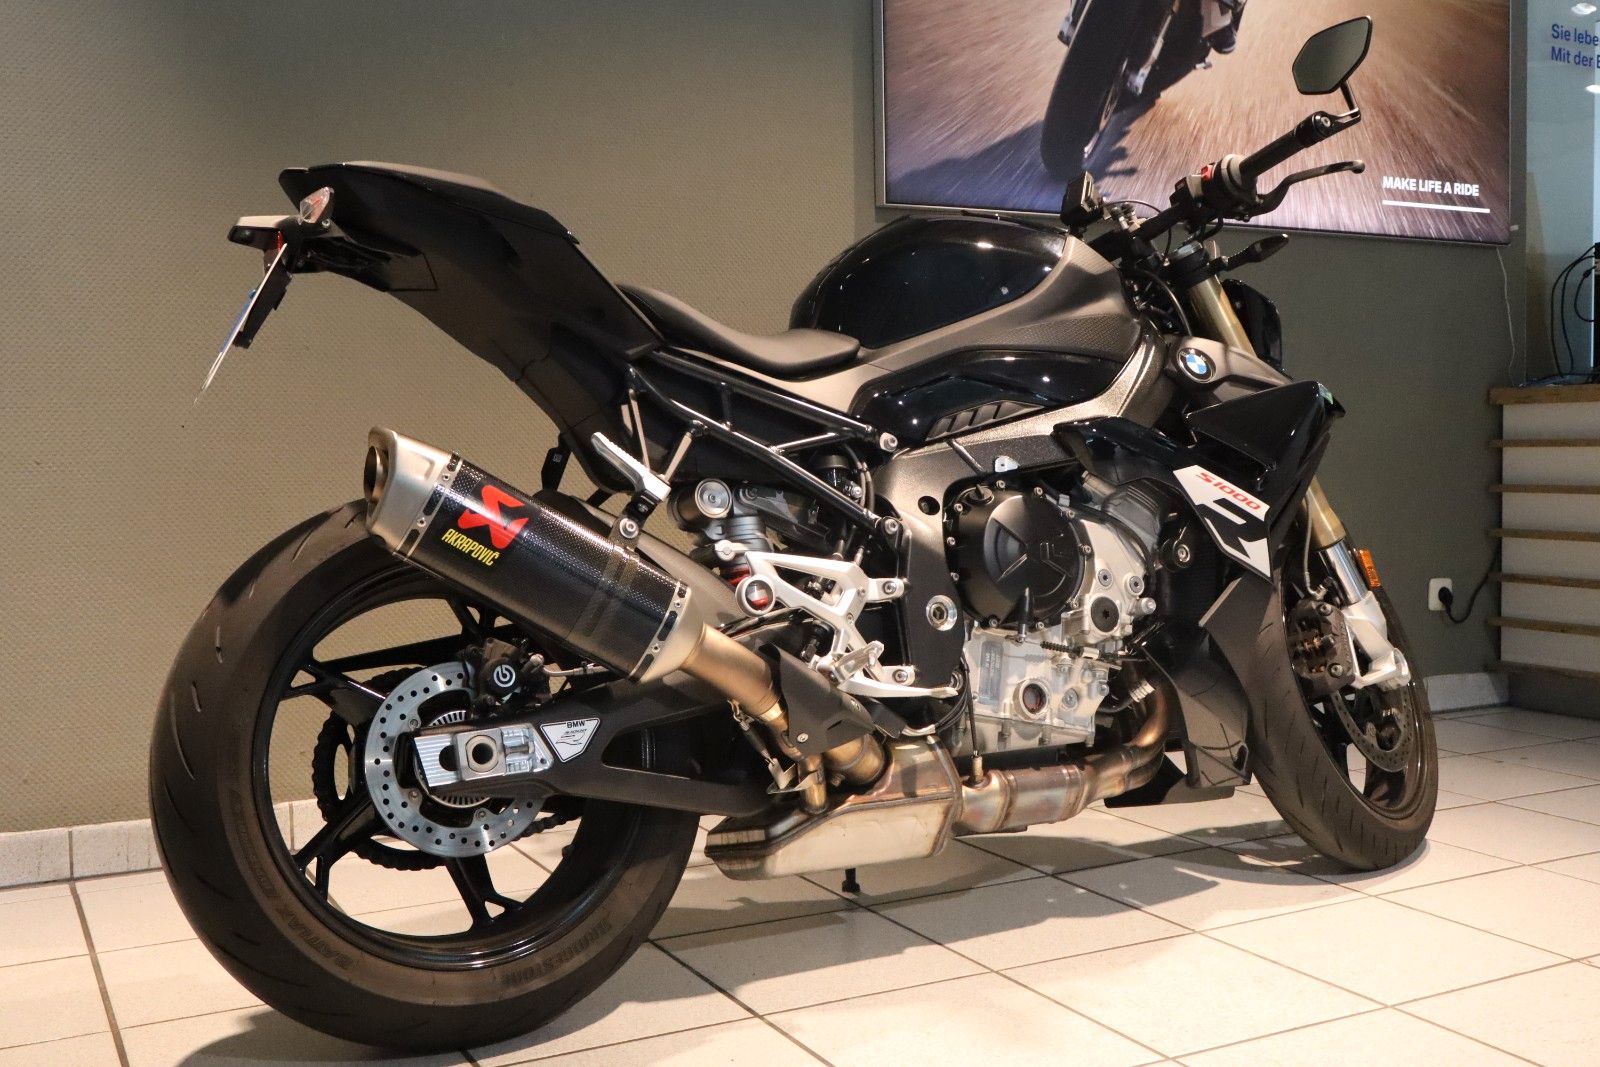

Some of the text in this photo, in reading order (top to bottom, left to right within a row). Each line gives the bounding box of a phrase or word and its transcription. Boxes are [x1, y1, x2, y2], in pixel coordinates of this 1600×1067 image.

[1551, 24, 1599, 46] Sie lebe
[1551, 46, 1571, 63] Mit
[1574, 51, 1593, 67] der
[1382, 176, 1480, 196] MAKE LIFE A RIDE
[1196, 472, 1261, 510] S1000
[566, 721, 586, 729] BMW
